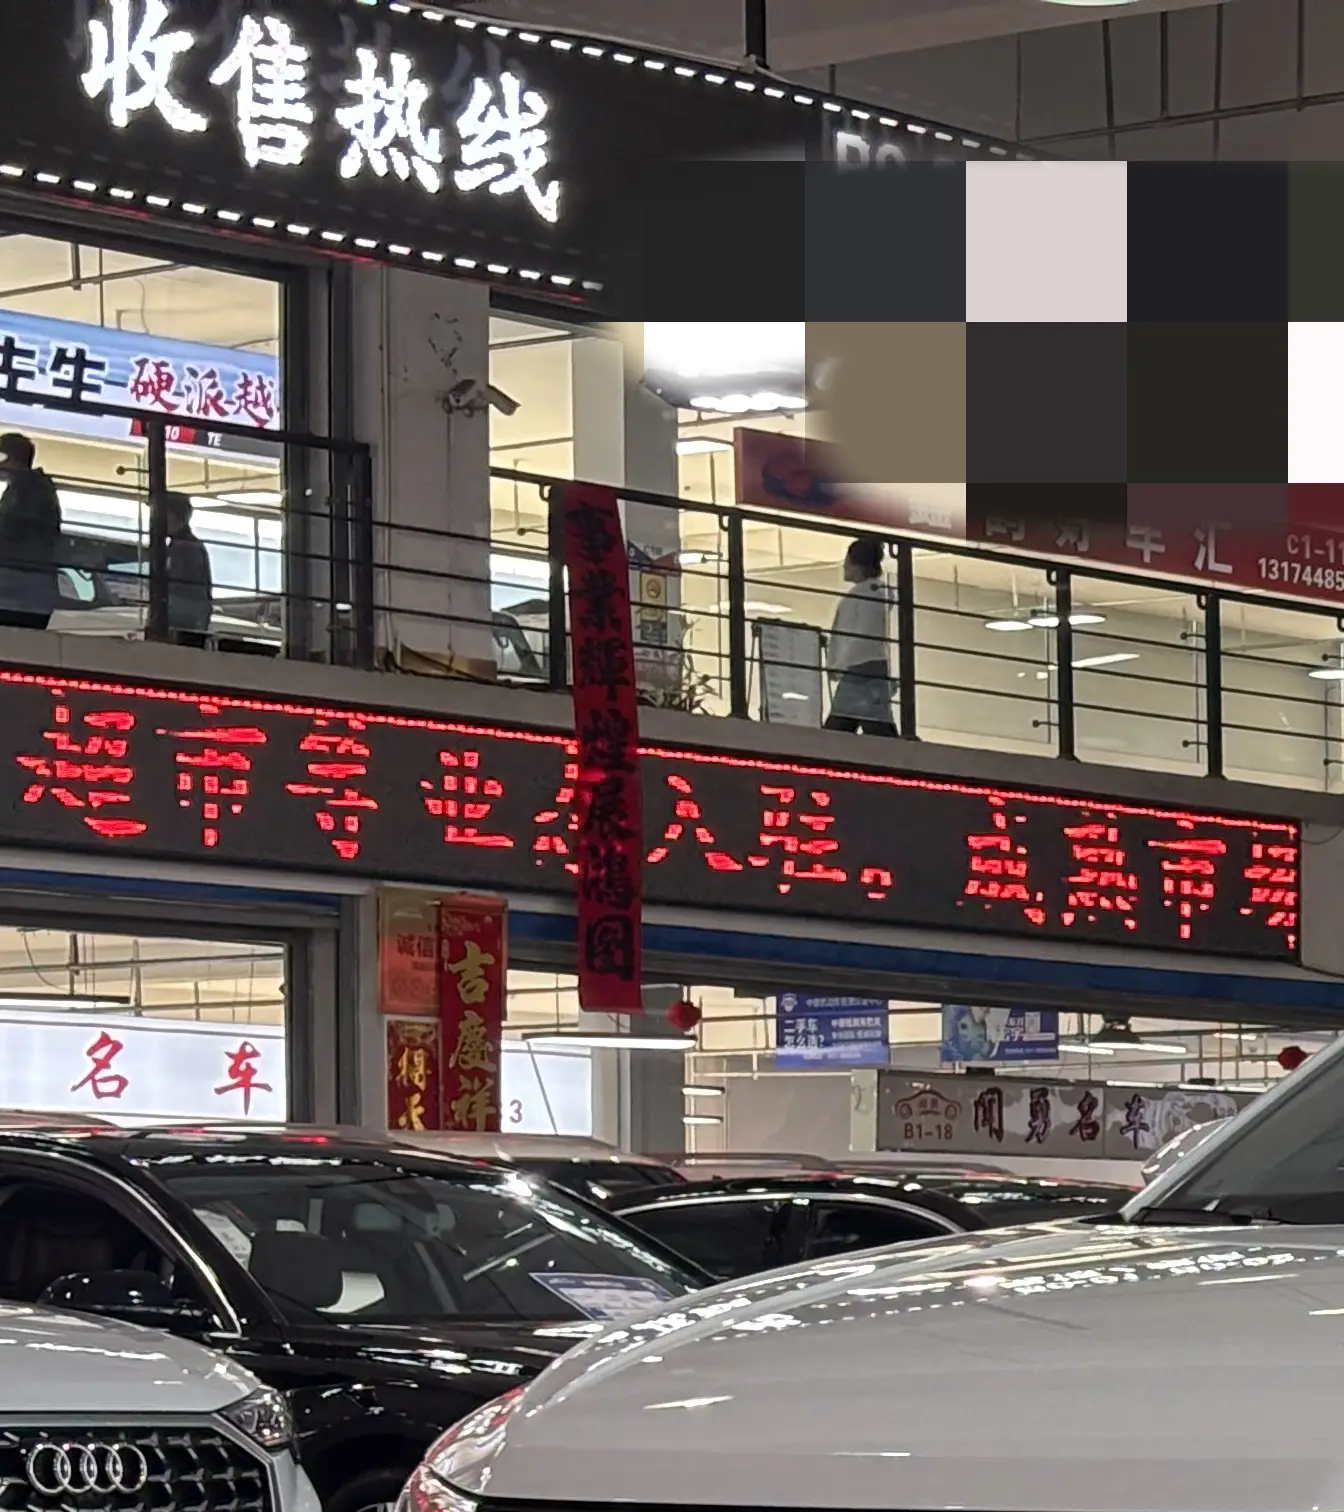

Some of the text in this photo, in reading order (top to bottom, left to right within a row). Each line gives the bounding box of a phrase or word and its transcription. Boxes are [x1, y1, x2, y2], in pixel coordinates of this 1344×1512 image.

[82, 0, 561, 223] 收售热线
[70, 1031, 274, 1117] 名车
[903, 1121, 954, 1140] B1-18
